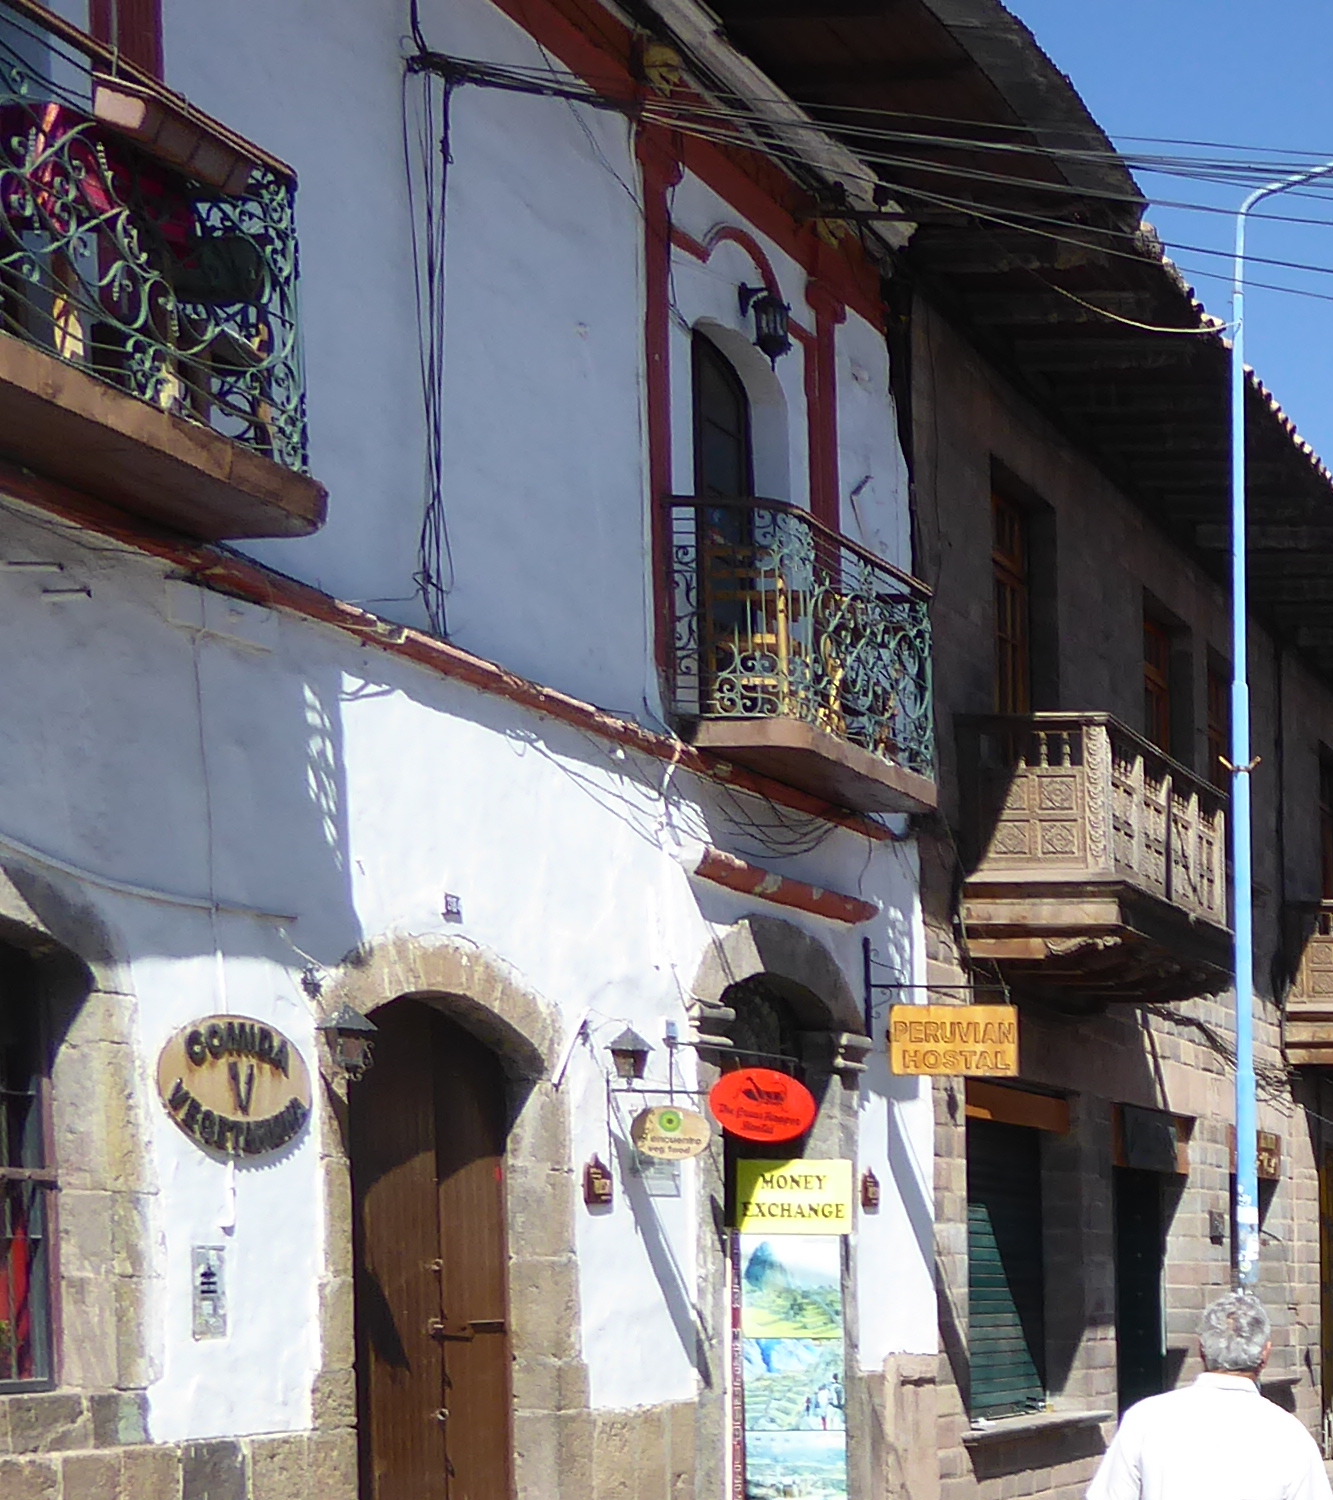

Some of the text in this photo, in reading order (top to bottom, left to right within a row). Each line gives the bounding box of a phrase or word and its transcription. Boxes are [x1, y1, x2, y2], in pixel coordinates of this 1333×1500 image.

[893, 1020, 1016, 1044] PERUVIAN
[184, 1021, 289, 1080] COMIDA
[902, 1049, 1011, 1070] HOSTAL
[227, 1061, 255, 1116] V
[650, 1136, 702, 1145] encuentro
[760, 1174, 827, 1189] MONEY
[742, 1202, 845, 1218] EXCHANGE
